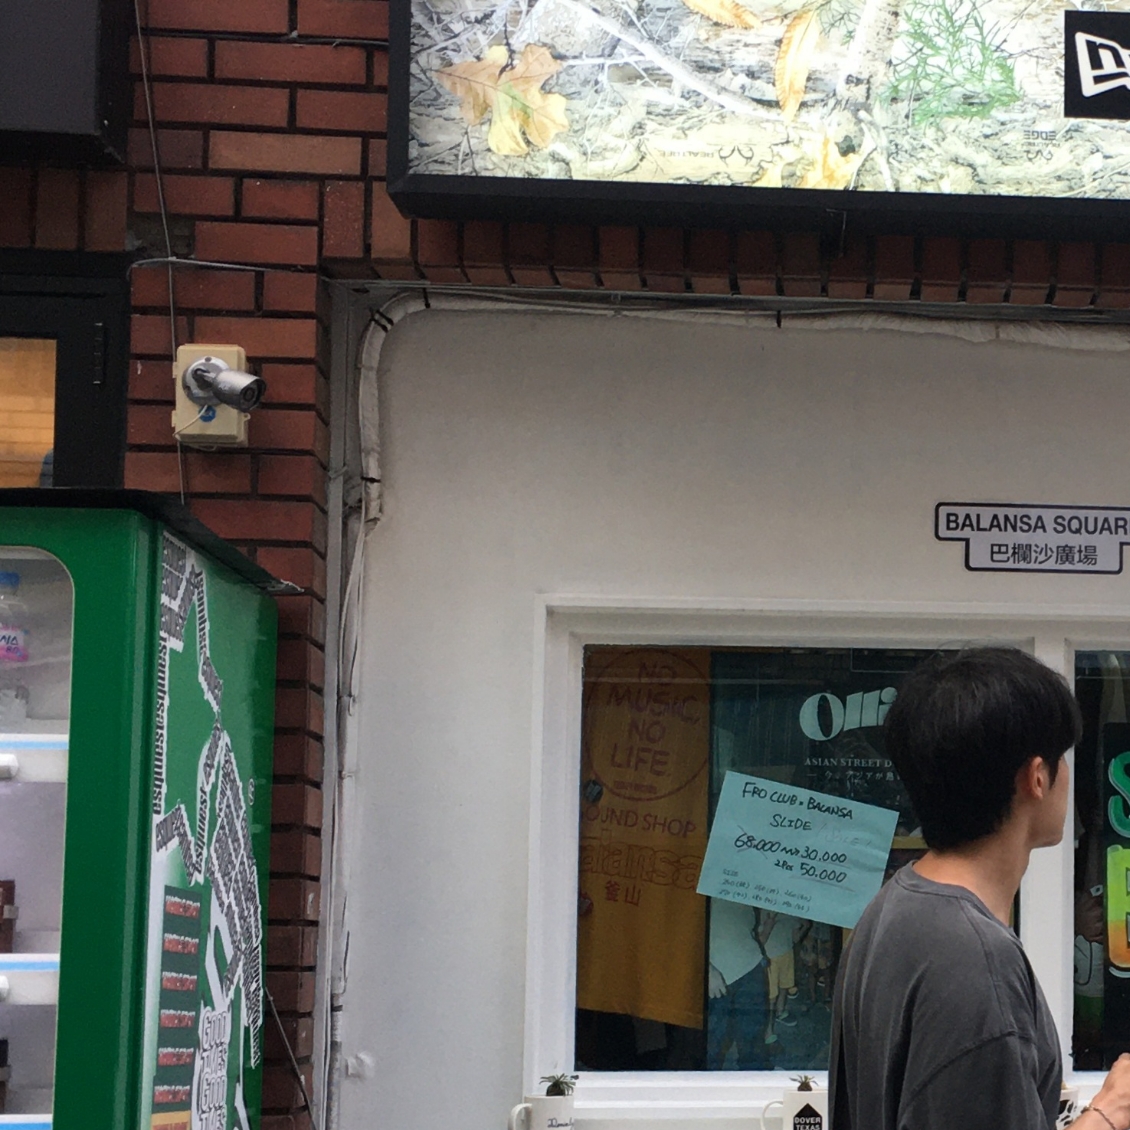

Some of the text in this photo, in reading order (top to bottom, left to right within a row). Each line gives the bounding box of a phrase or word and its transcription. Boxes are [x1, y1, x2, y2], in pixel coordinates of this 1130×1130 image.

[945, 512, 1047, 533] BALANSA
[629, 721, 666, 743] NO
[803, 757, 838, 766] ASIAN
[840, 758, 882, 768] STREET
[742, 781, 768, 799] FRO
[769, 790, 796, 807] CLUB
[807, 796, 854, 820] BALANSA
[580, 805, 697, 839] OUND SHOP
[769, 813, 813, 831] SLIDE
[800, 845, 848, 864] 30.000
[799, 862, 848, 884] 50.000
[605, 879, 642, 906] 釜山
[794, 1116, 821, 1124] DOVER
